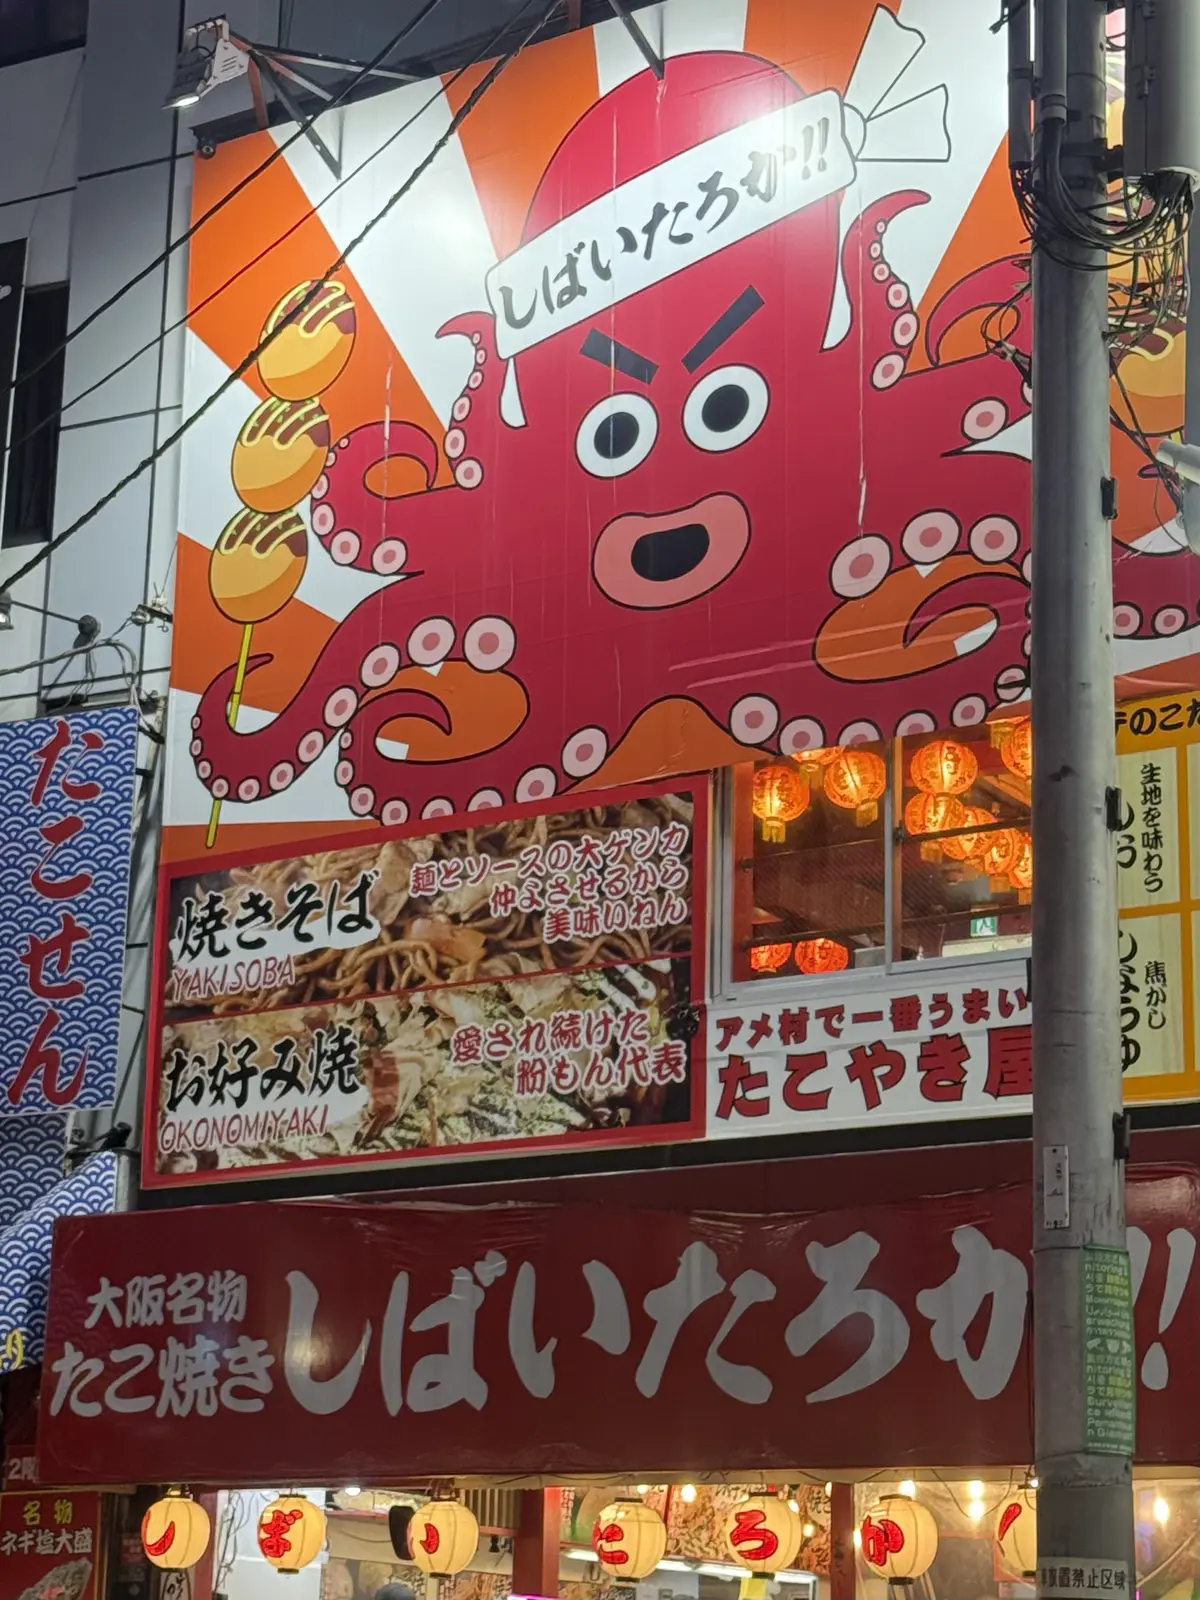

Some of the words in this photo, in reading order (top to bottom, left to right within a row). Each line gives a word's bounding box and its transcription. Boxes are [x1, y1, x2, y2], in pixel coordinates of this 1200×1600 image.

[499, 116, 831, 330] しばいたろか!!
[1141, 762, 1164, 893] 生地を味わう
[411, 822, 689, 896] 麺とソースの大ゲンカ
[491, 857, 688, 915] 仲よさせるから
[8, 720, 105, 1106] たこせん
[176, 869, 381, 962] 焼きそば
[545, 892, 688, 943] 美味いねん
[172, 954, 296, 1003] YAKISOBA
[453, 1007, 650, 1062] 愛され続けた
[715, 987, 1029, 1051] アメ村で一番うまい
[166, 1025, 360, 1112] お好み焼
[517, 1040, 686, 1096] 粉もん代表
[715, 1022, 1033, 1120] たこやき屋
[160, 1104, 329, 1153] OKONOMIYAKI
[84, 1270, 247, 1328] 大阪名物
[49, 1335, 275, 1418] たこ焼き
[23, 1500, 73, 1525] 名物
[730, 1509, 778, 1560] ろ
